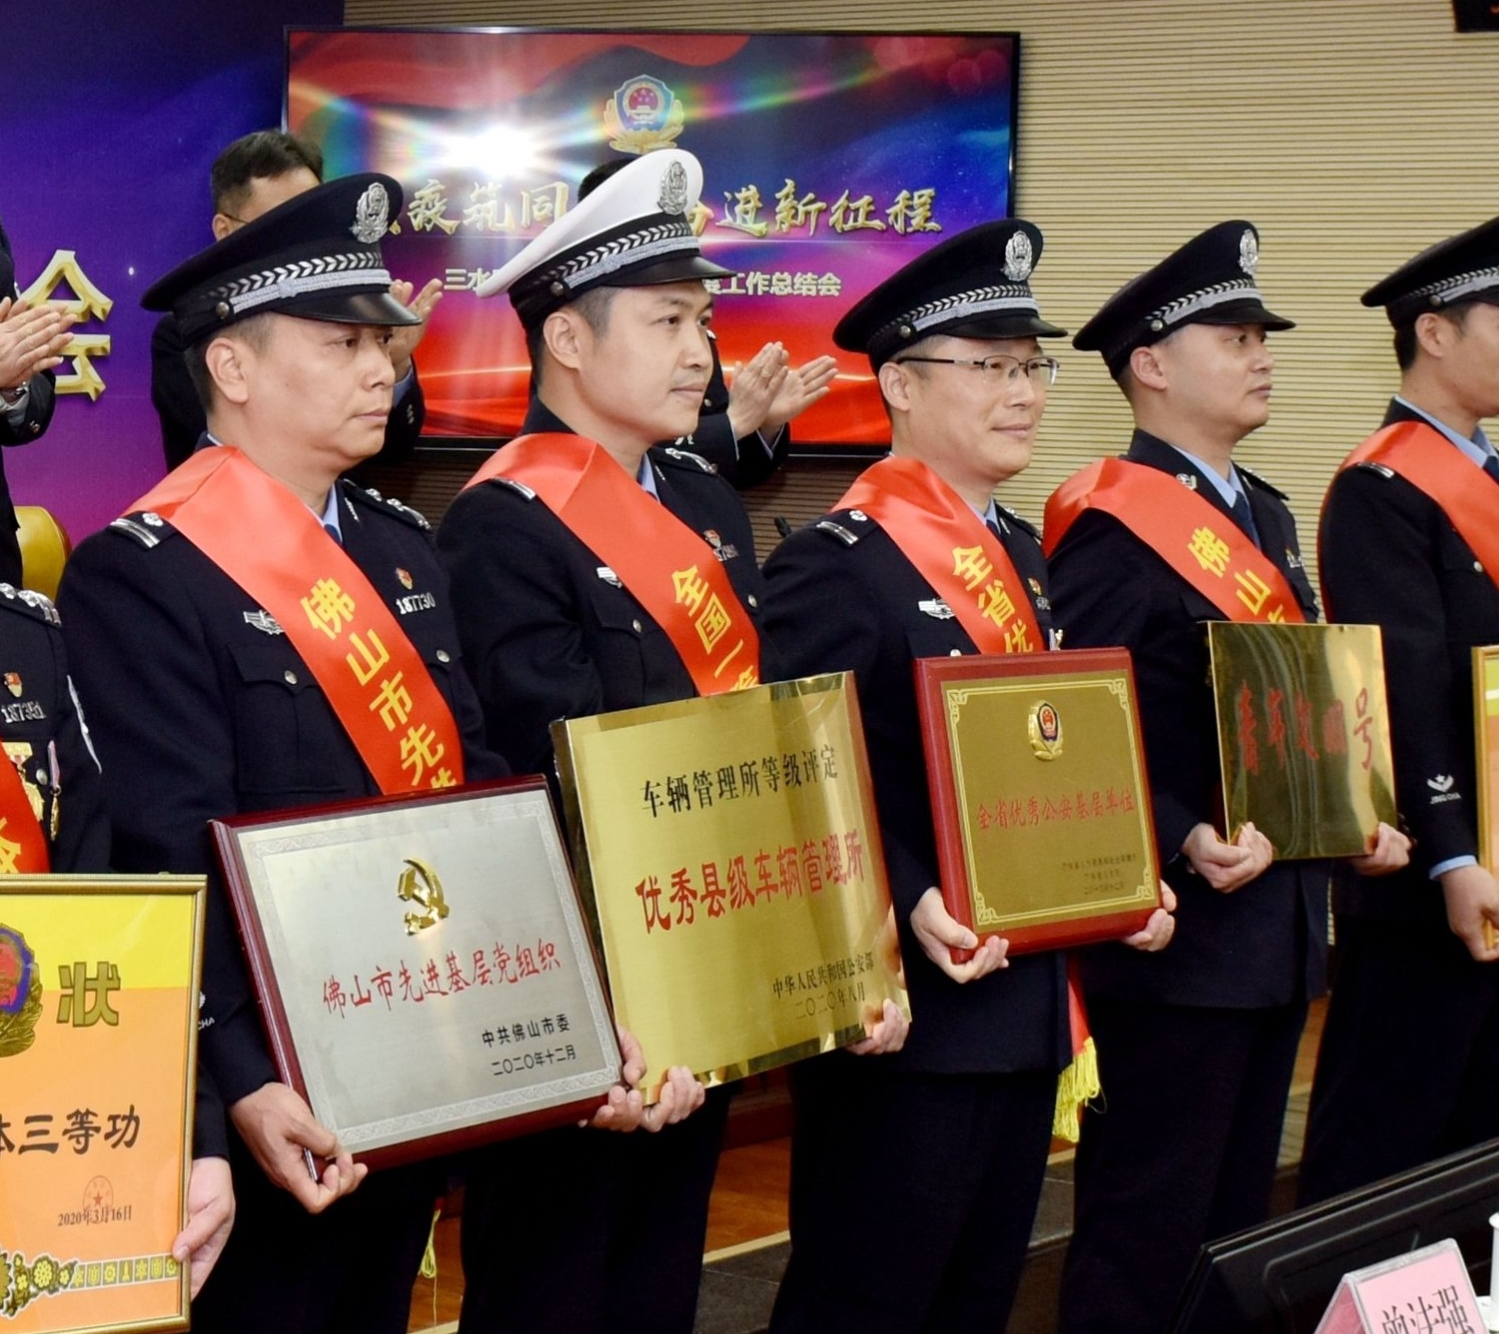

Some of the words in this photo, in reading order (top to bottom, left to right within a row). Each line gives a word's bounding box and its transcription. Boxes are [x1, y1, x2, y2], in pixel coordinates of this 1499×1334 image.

[640, 743, 839, 819] 车辆管理所等级评定
[635, 829, 864, 934] 优秀县级车辆管理所
[322, 938, 563, 1020] 佛山市先进基层党组织
[481, 1013, 571, 1049] 中共佛山市委
